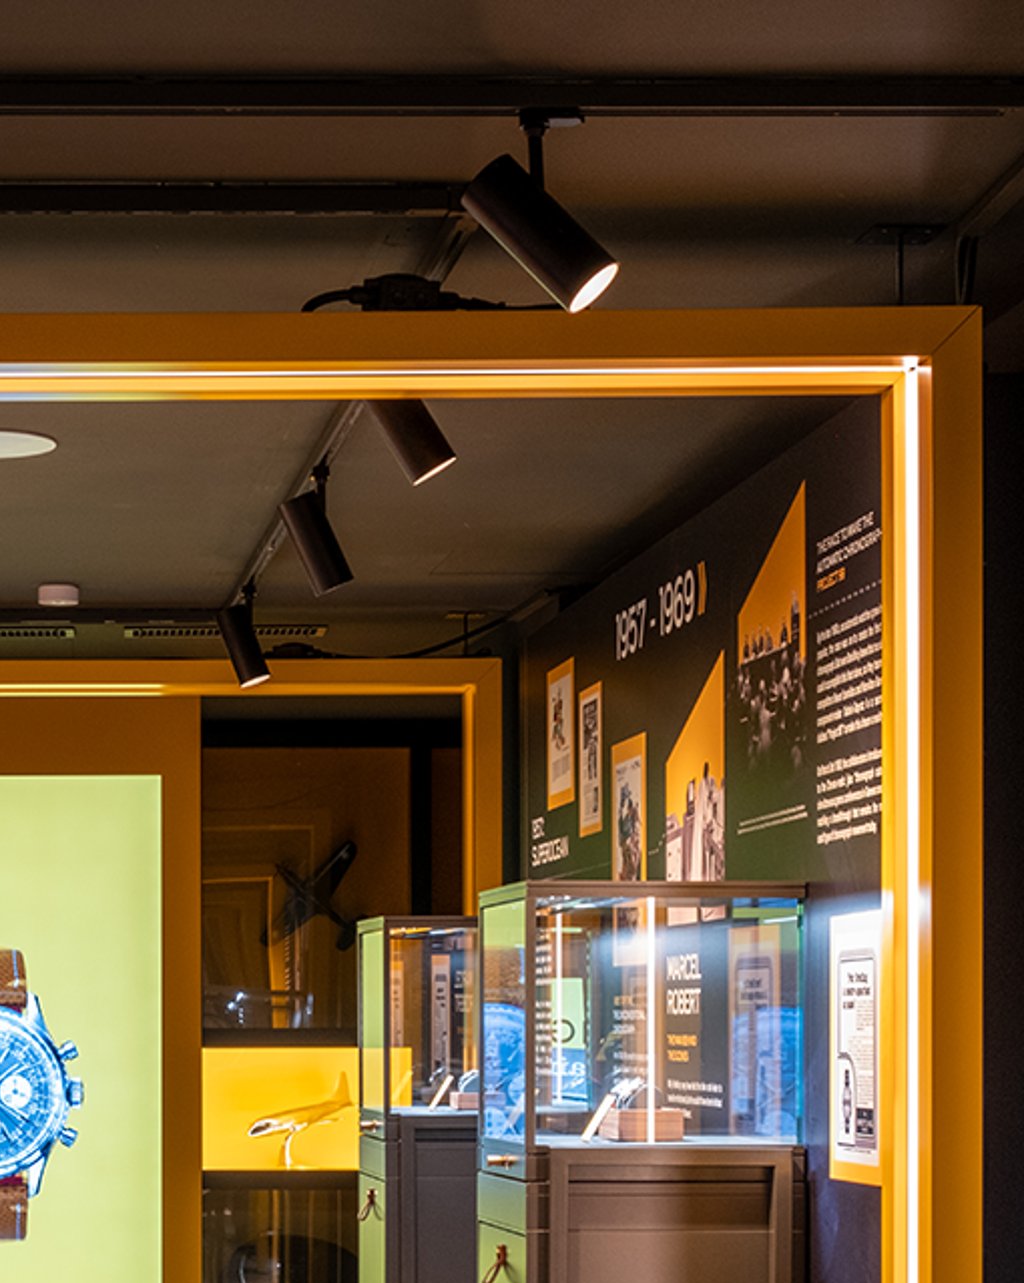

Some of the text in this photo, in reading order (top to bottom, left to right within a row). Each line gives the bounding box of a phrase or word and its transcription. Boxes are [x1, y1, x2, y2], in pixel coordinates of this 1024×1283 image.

[614, 598, 649, 661] 1957
[658, 568, 696, 637] 1969
[666, 953, 701, 981] MARCEL
[666, 987, 701, 1016] ROBERT
